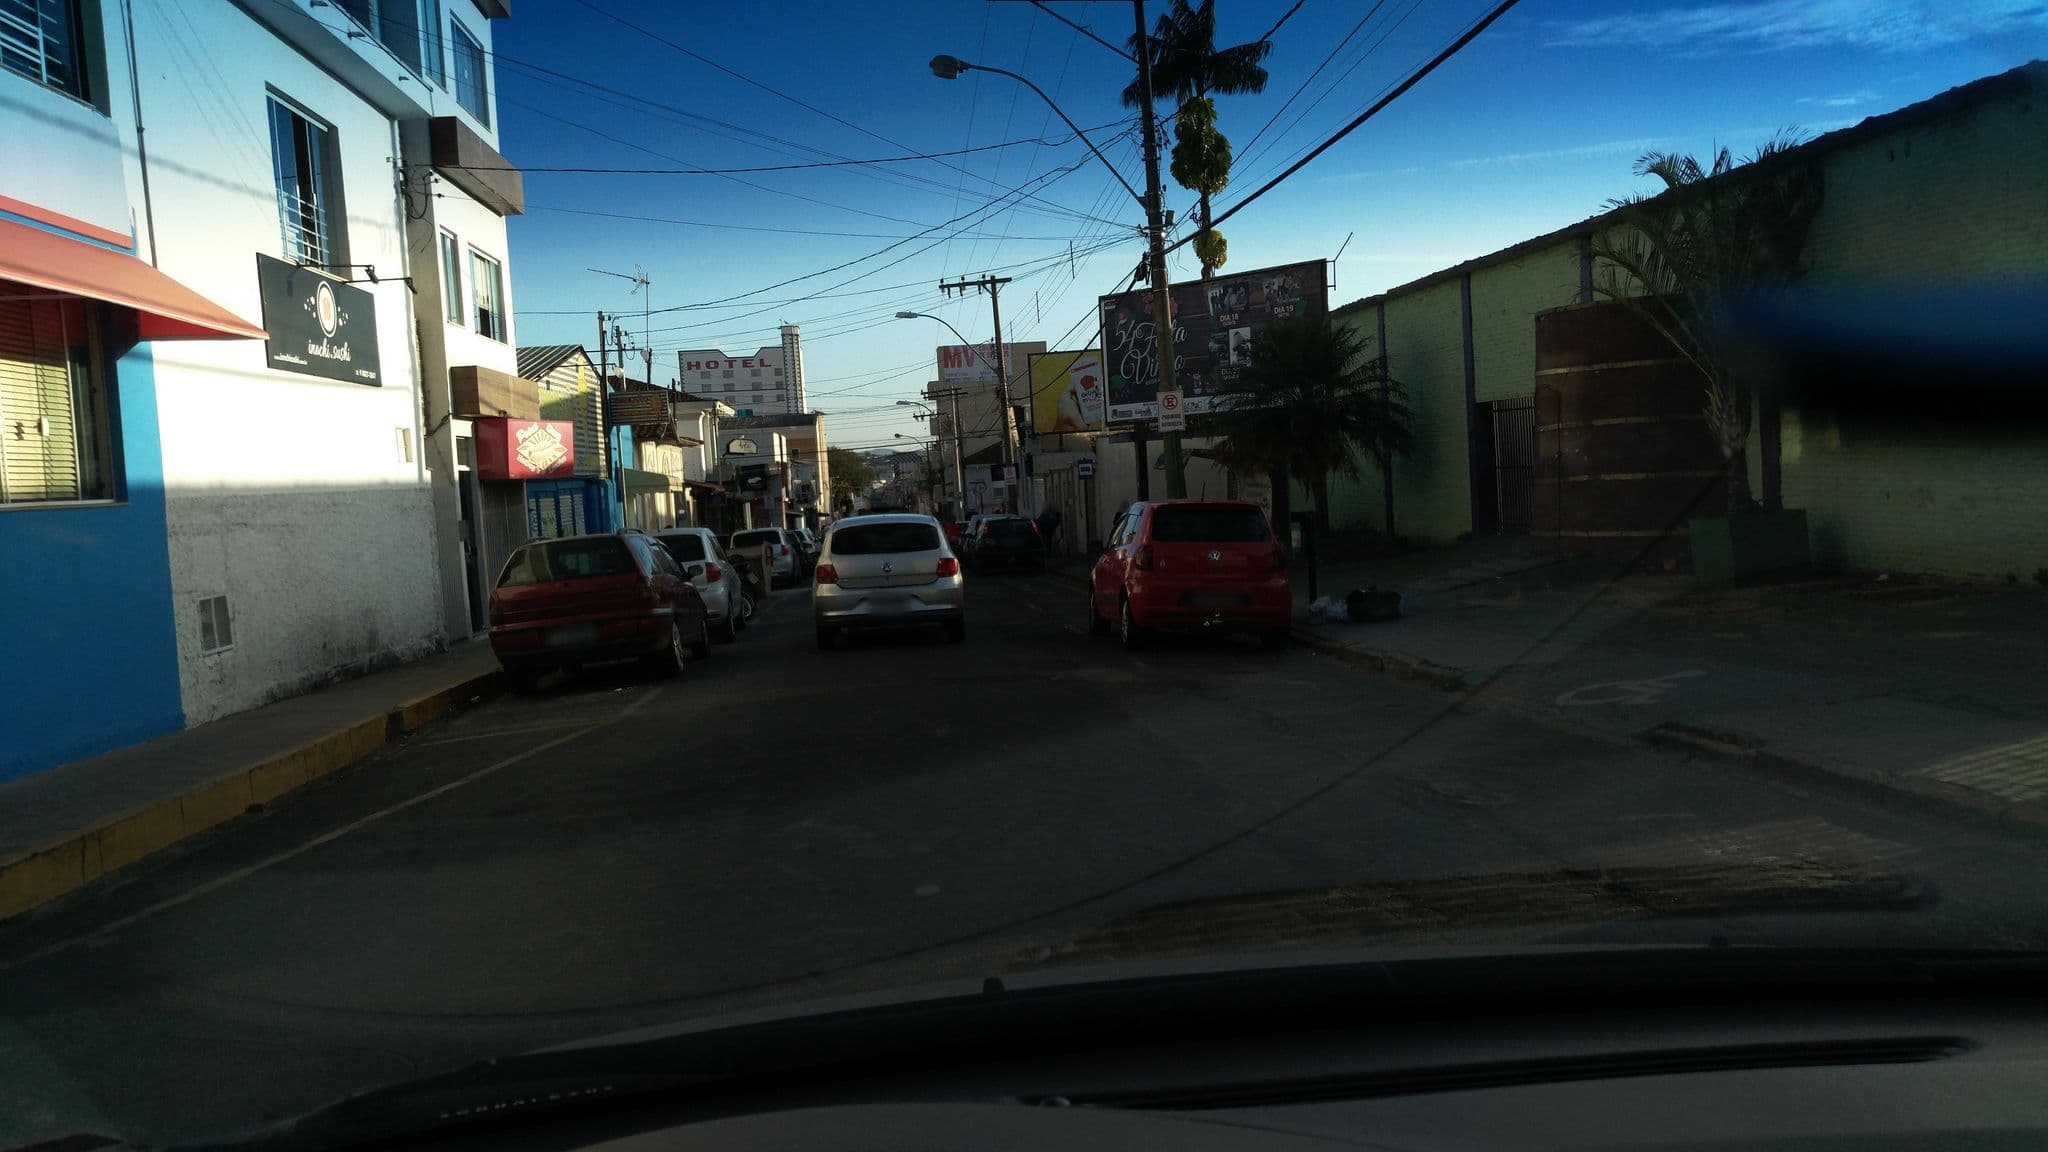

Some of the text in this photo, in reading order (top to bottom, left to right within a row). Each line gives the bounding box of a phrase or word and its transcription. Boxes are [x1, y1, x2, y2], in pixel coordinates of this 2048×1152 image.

[1134, 318, 1187, 358] Fta
[687, 358, 772, 370] HOTEL
[943, 345, 975, 369] MV
